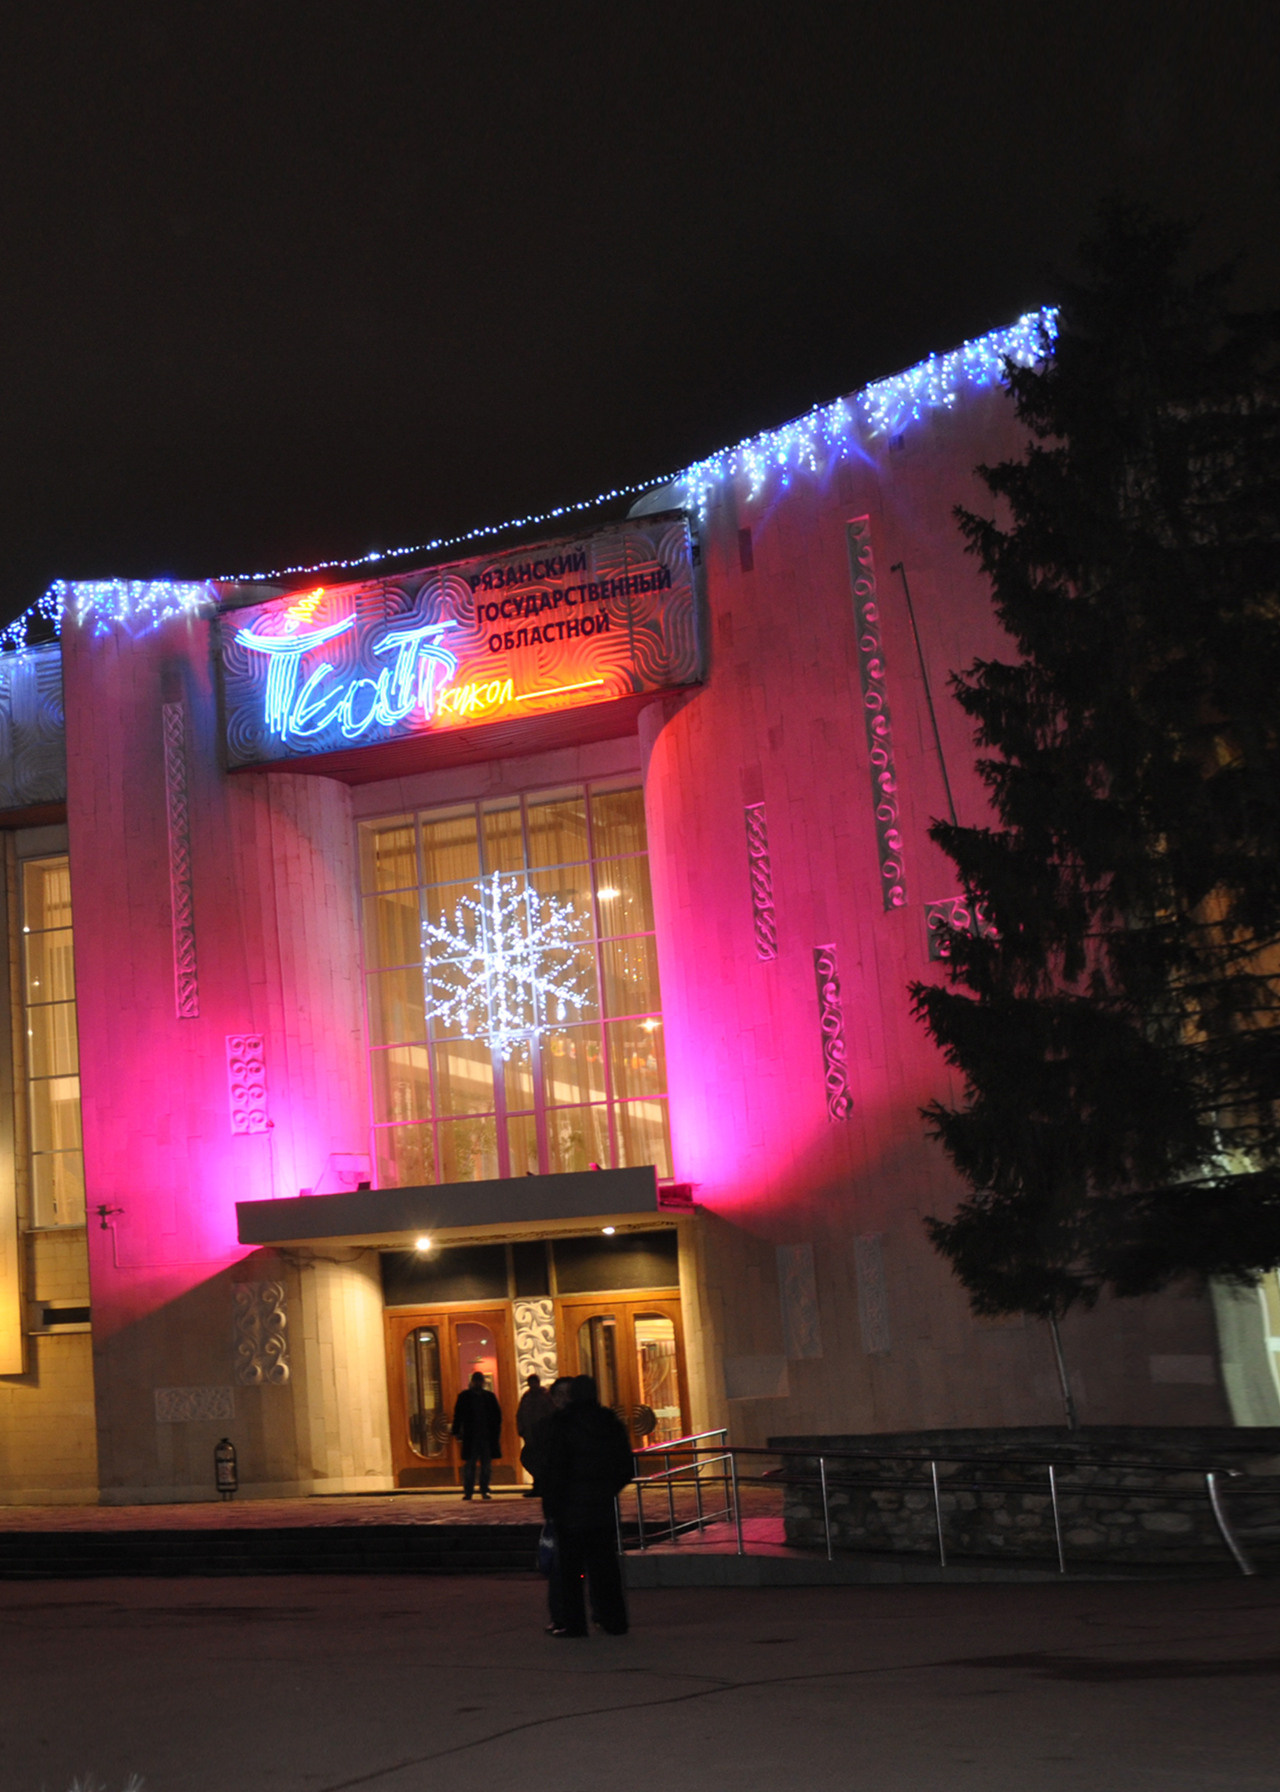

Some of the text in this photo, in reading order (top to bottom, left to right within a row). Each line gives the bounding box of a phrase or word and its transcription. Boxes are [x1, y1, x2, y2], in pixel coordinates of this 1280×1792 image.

[470, 547, 587, 593] РЯЗАНСКИЙ
[477, 565, 671, 623] ГОСУДАРСТВЕННЫЙ
[488, 609, 610, 652] ОБЛАСТНОЙ
